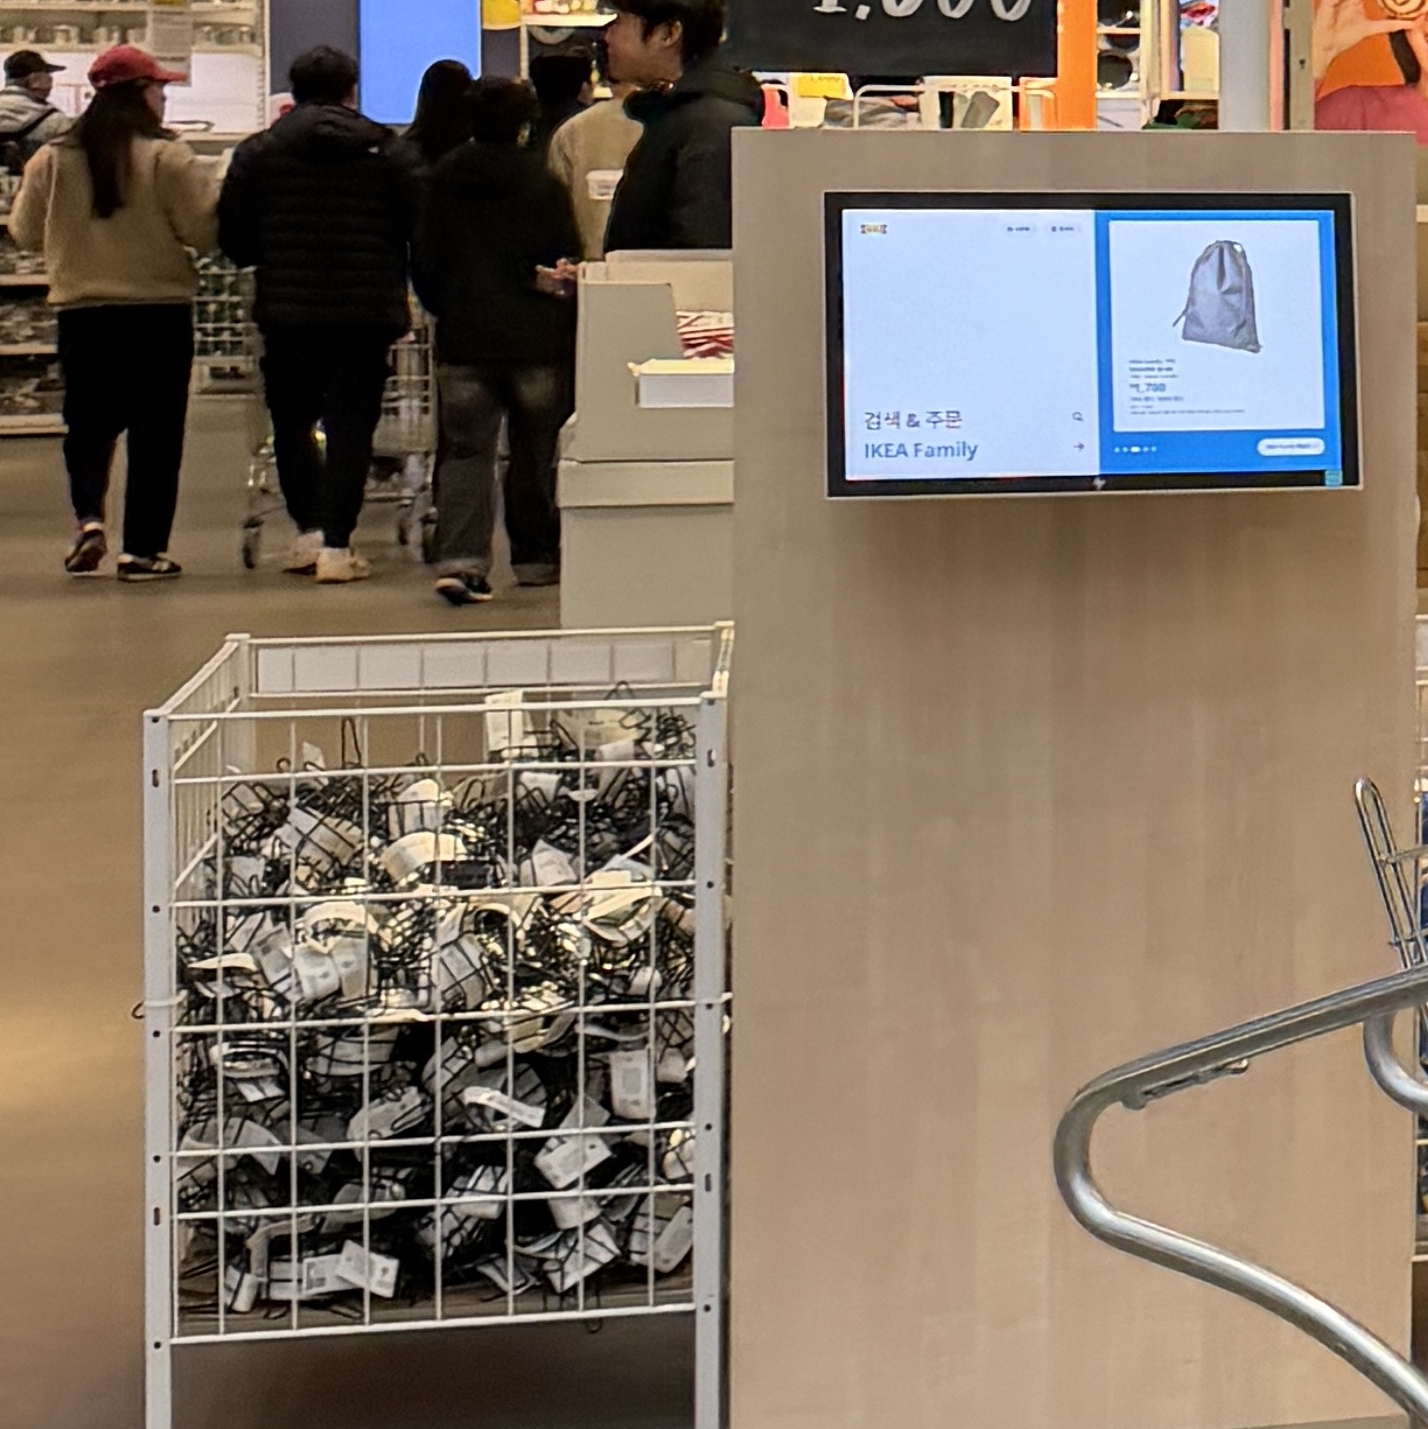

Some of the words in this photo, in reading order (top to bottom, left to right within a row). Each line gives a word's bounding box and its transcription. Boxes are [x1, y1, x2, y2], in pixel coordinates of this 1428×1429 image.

[864, 411, 900, 430] 검색
[925, 410, 961, 430] 주문
[864, 442, 908, 459] IKEA
[913, 440, 978, 462] Family
